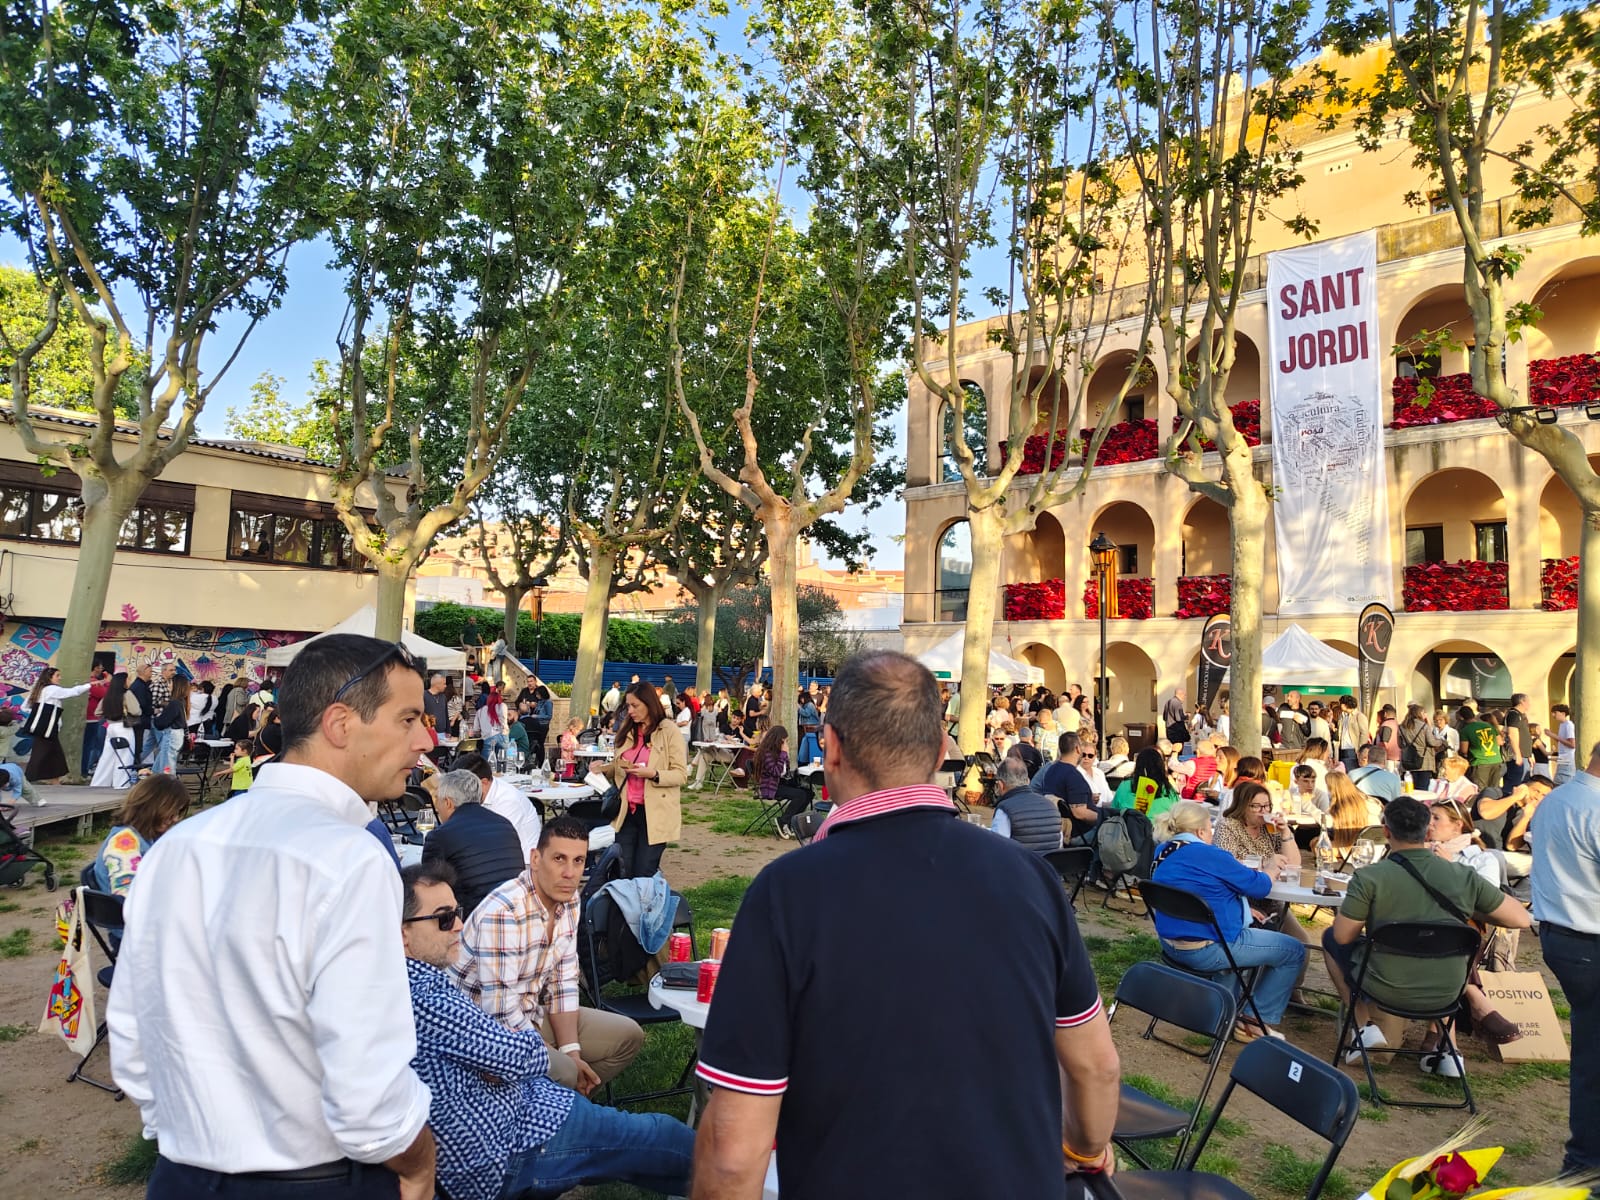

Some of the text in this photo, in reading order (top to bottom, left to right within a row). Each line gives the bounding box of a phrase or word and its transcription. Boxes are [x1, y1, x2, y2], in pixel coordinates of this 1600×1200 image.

[1280, 266, 1364, 320] SANT
[1280, 320, 1369, 374] JORDI
[1303, 405, 1340, 418] cultura
[1208, 628, 1231, 659] K
[1364, 621, 1387, 653] K
[1488, 990, 1543, 1000] POSITIVO
[1292, 1067, 1299, 1077] 2
